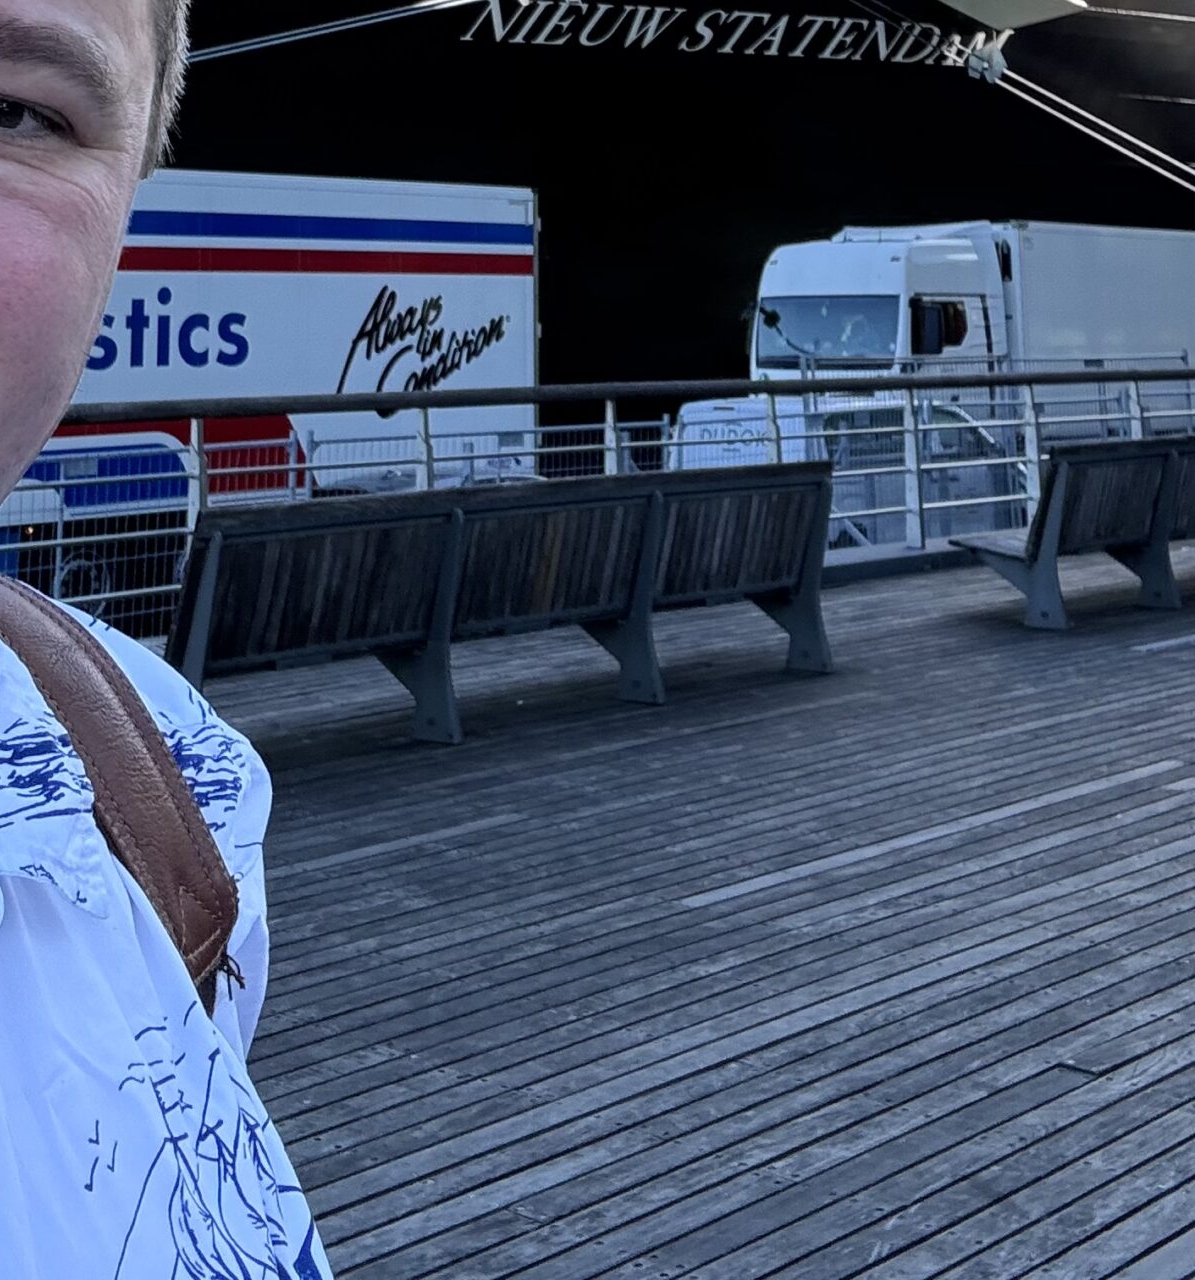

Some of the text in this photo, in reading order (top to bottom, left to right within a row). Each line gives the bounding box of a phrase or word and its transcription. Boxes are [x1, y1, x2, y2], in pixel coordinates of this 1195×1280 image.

[336, 284, 443, 394] Always
[376, 314, 508, 419] Condition
[421, 327, 445, 362] in
